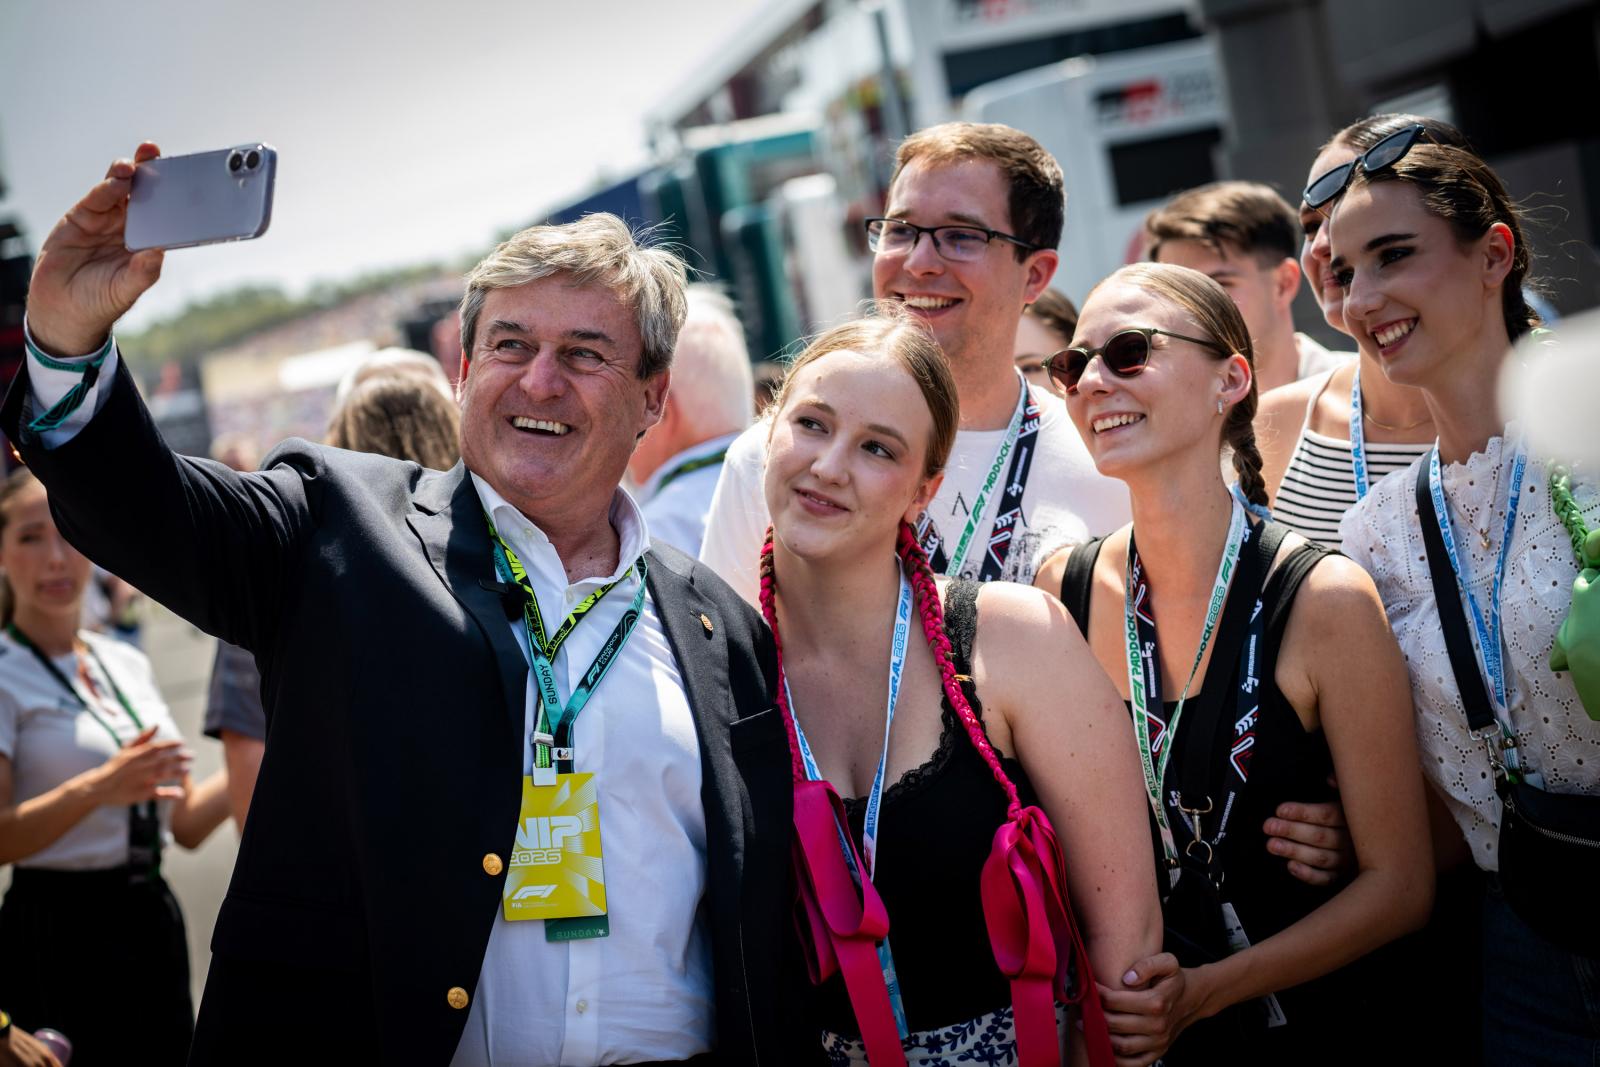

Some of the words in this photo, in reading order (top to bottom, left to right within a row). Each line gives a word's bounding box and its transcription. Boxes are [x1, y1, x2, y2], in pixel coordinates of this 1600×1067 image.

[983, 442, 1011, 494] PADDOCK
[1127, 614, 1141, 676] PADDOCK
[539, 664, 558, 704] SUNDAY
[556, 928, 598, 939] SUNDAY
